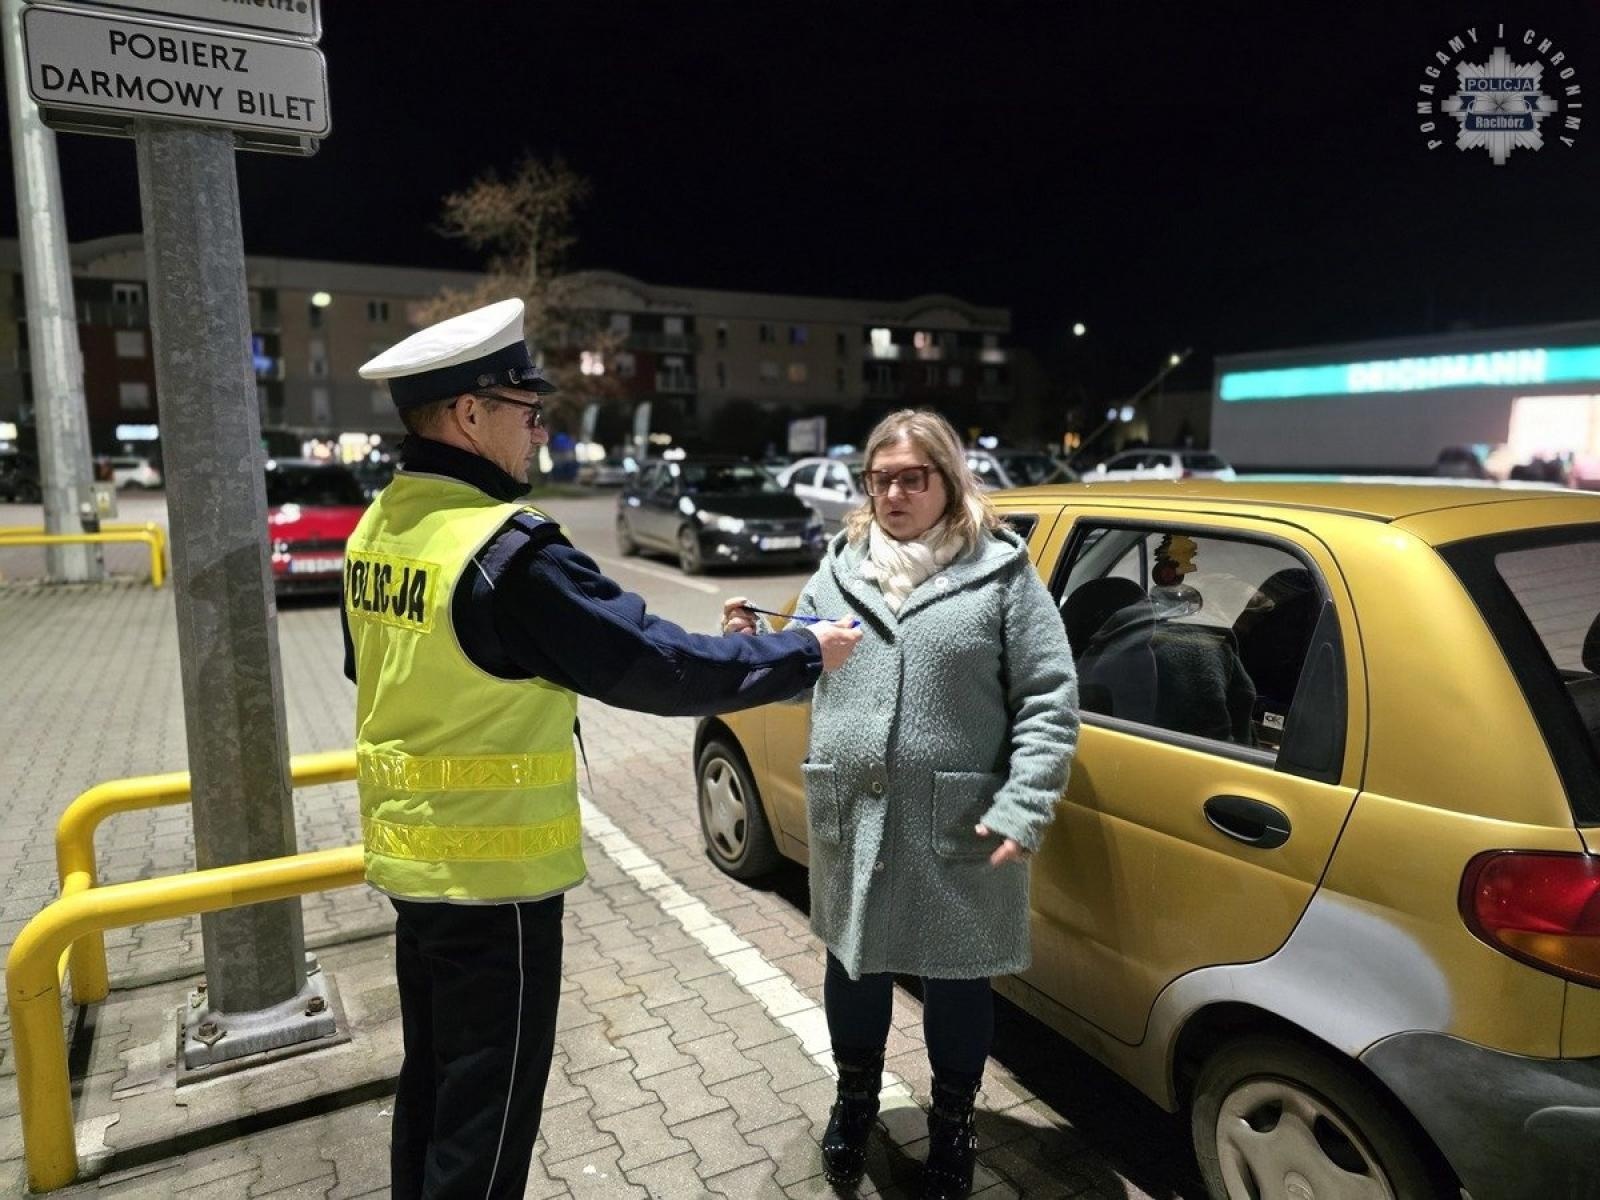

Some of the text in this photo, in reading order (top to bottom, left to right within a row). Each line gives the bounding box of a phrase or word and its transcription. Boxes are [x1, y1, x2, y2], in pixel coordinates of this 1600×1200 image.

[109, 30, 249, 72] POBIERZ
[41, 64, 315, 121] DARMOWY BILET
